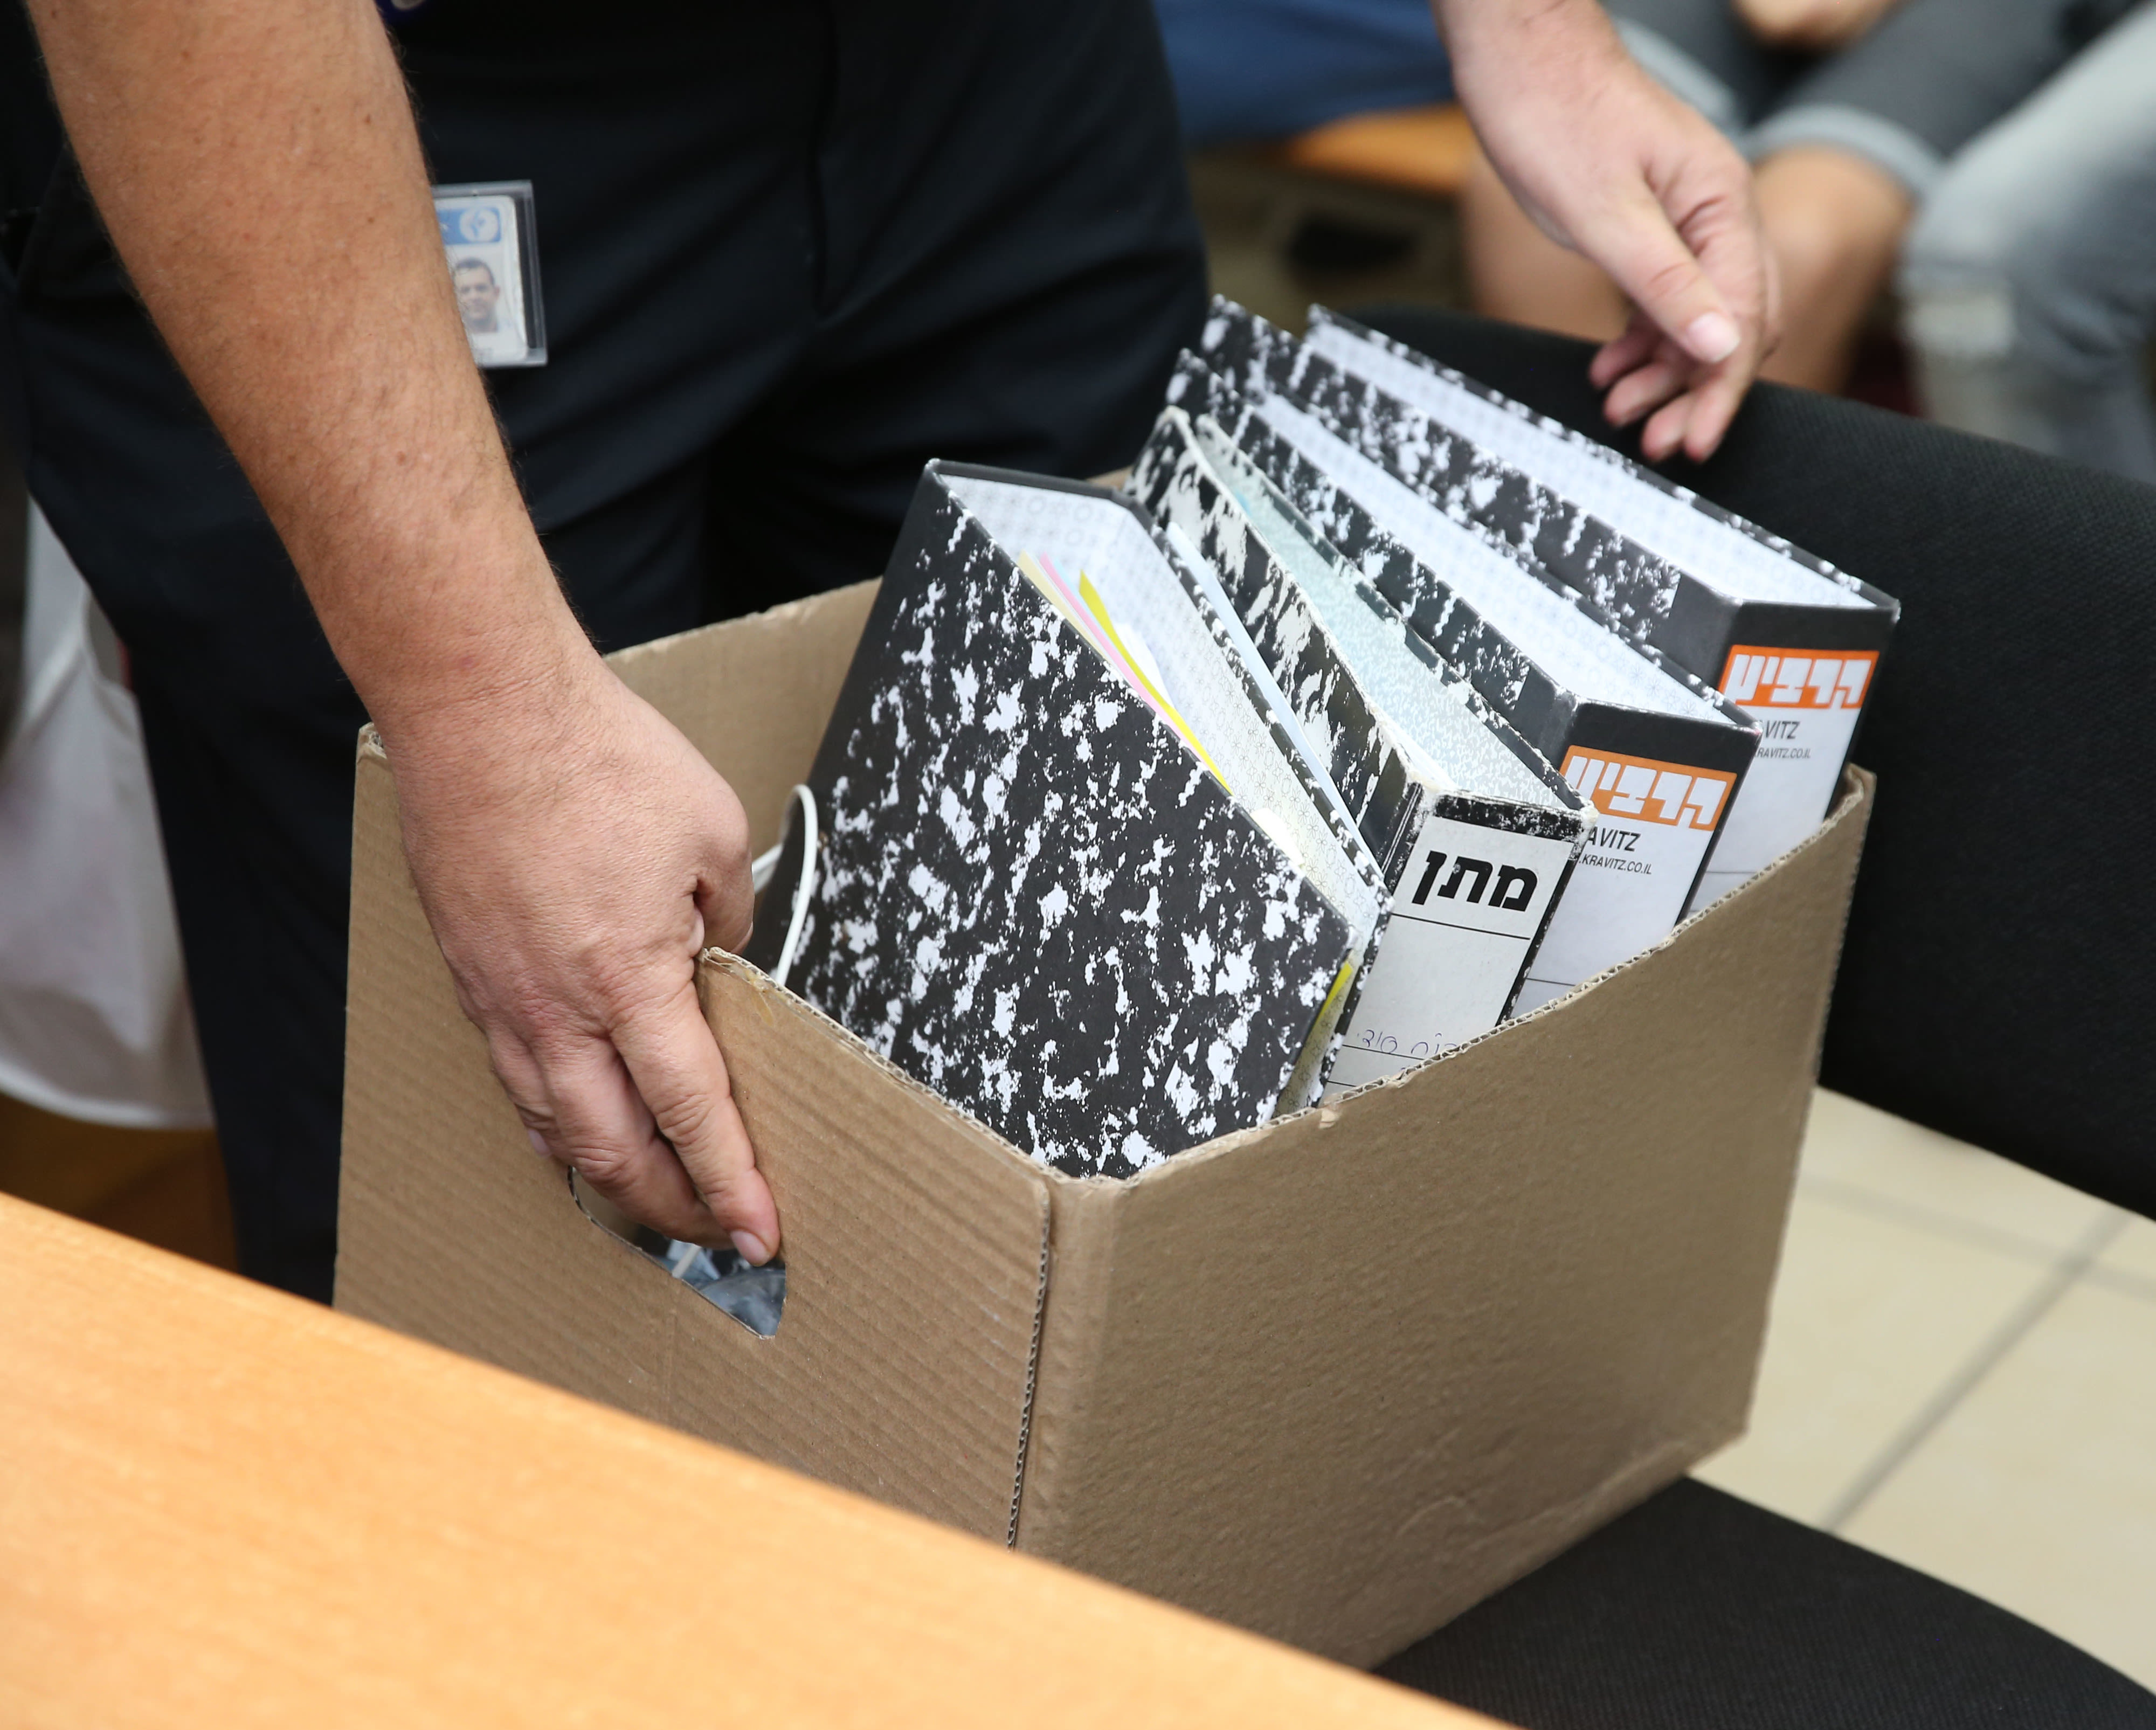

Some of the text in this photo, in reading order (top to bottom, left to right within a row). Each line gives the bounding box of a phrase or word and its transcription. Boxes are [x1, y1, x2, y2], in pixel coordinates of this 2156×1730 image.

[1766, 720, 1801, 739] VITZ
[1756, 747, 1811, 759] RAVITZ.CO.IL
[1587, 826, 1642, 852] AVITZ
[1579, 854, 1652, 875] .KRAVITZ.CO.IL
[1412, 850, 1538, 912] מתן
